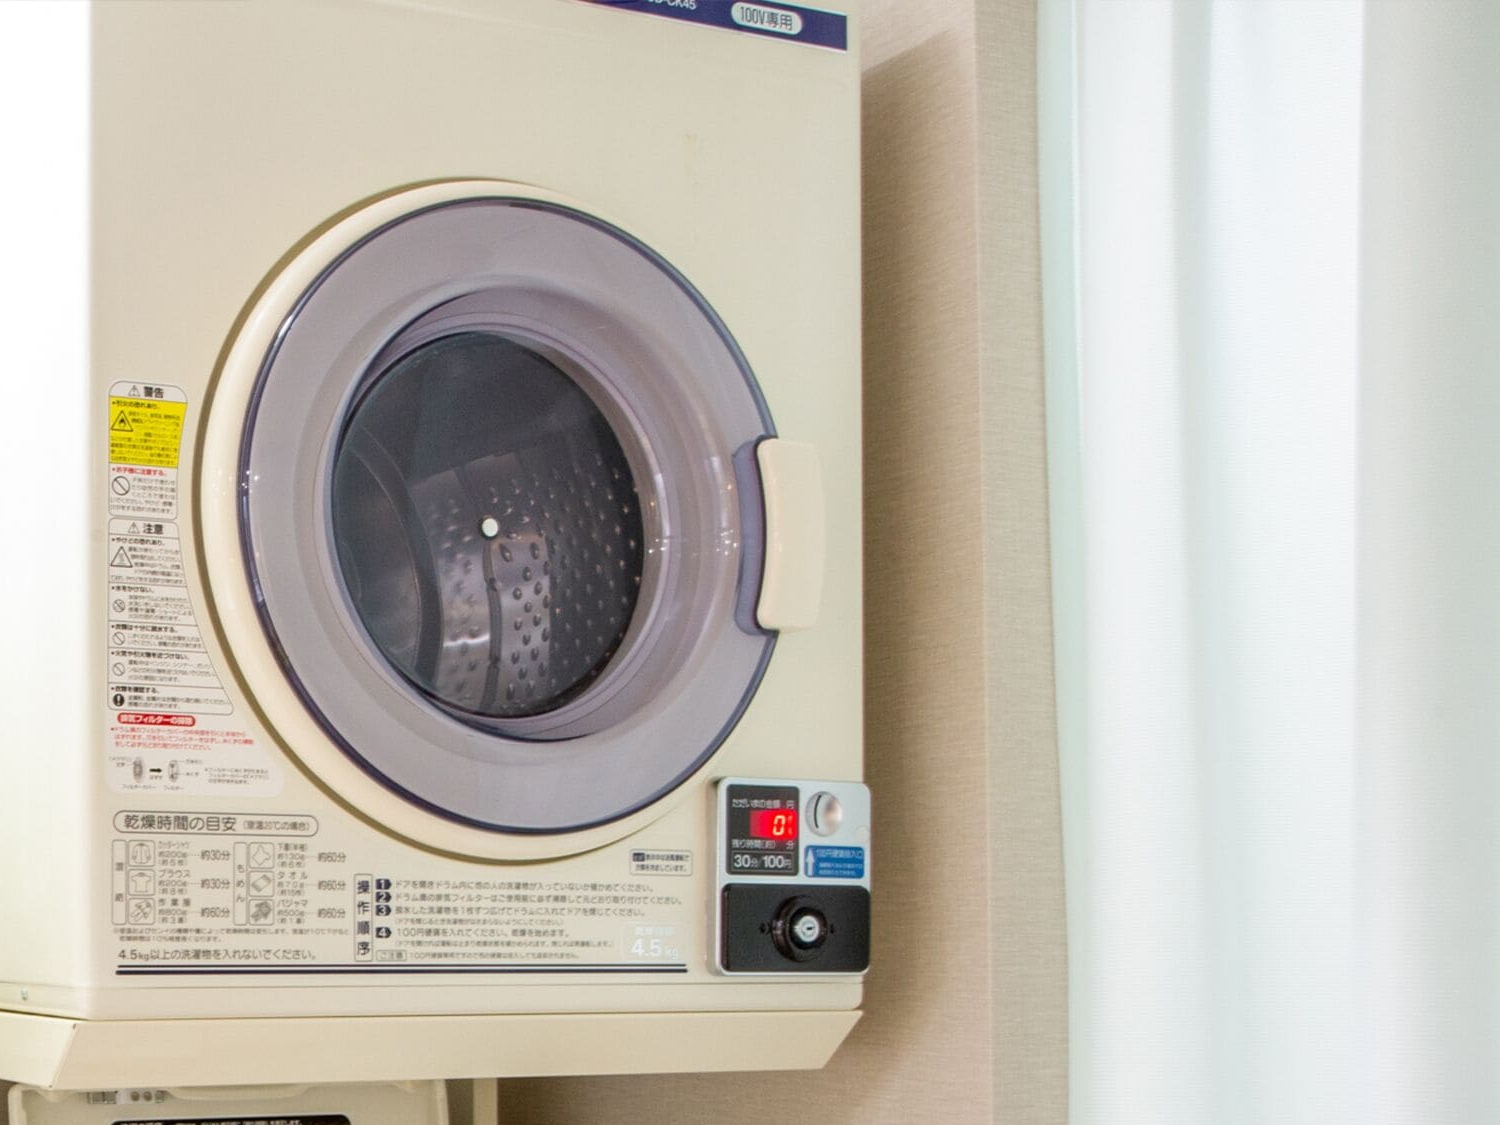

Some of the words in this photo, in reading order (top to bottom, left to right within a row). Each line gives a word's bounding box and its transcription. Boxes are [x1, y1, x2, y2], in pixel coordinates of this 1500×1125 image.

[739, 6, 794, 31] 100V専用
[143, 387, 163, 398] 警告
[143, 523, 163, 534] 注意
[124, 815, 237, 832] 乾燥時間の目安
[773, 815, 786, 836] 0
[201, 850, 230, 861] 約30分
[318, 853, 346, 863] 約60分
[201, 879, 230, 889] 約30分
[318, 881, 346, 891] 約60分
[201, 907, 230, 917] 約60分
[318, 908, 345, 918] 約60分
[357, 880, 370, 956] 操作順序
[631, 939, 661, 957] 4.5
